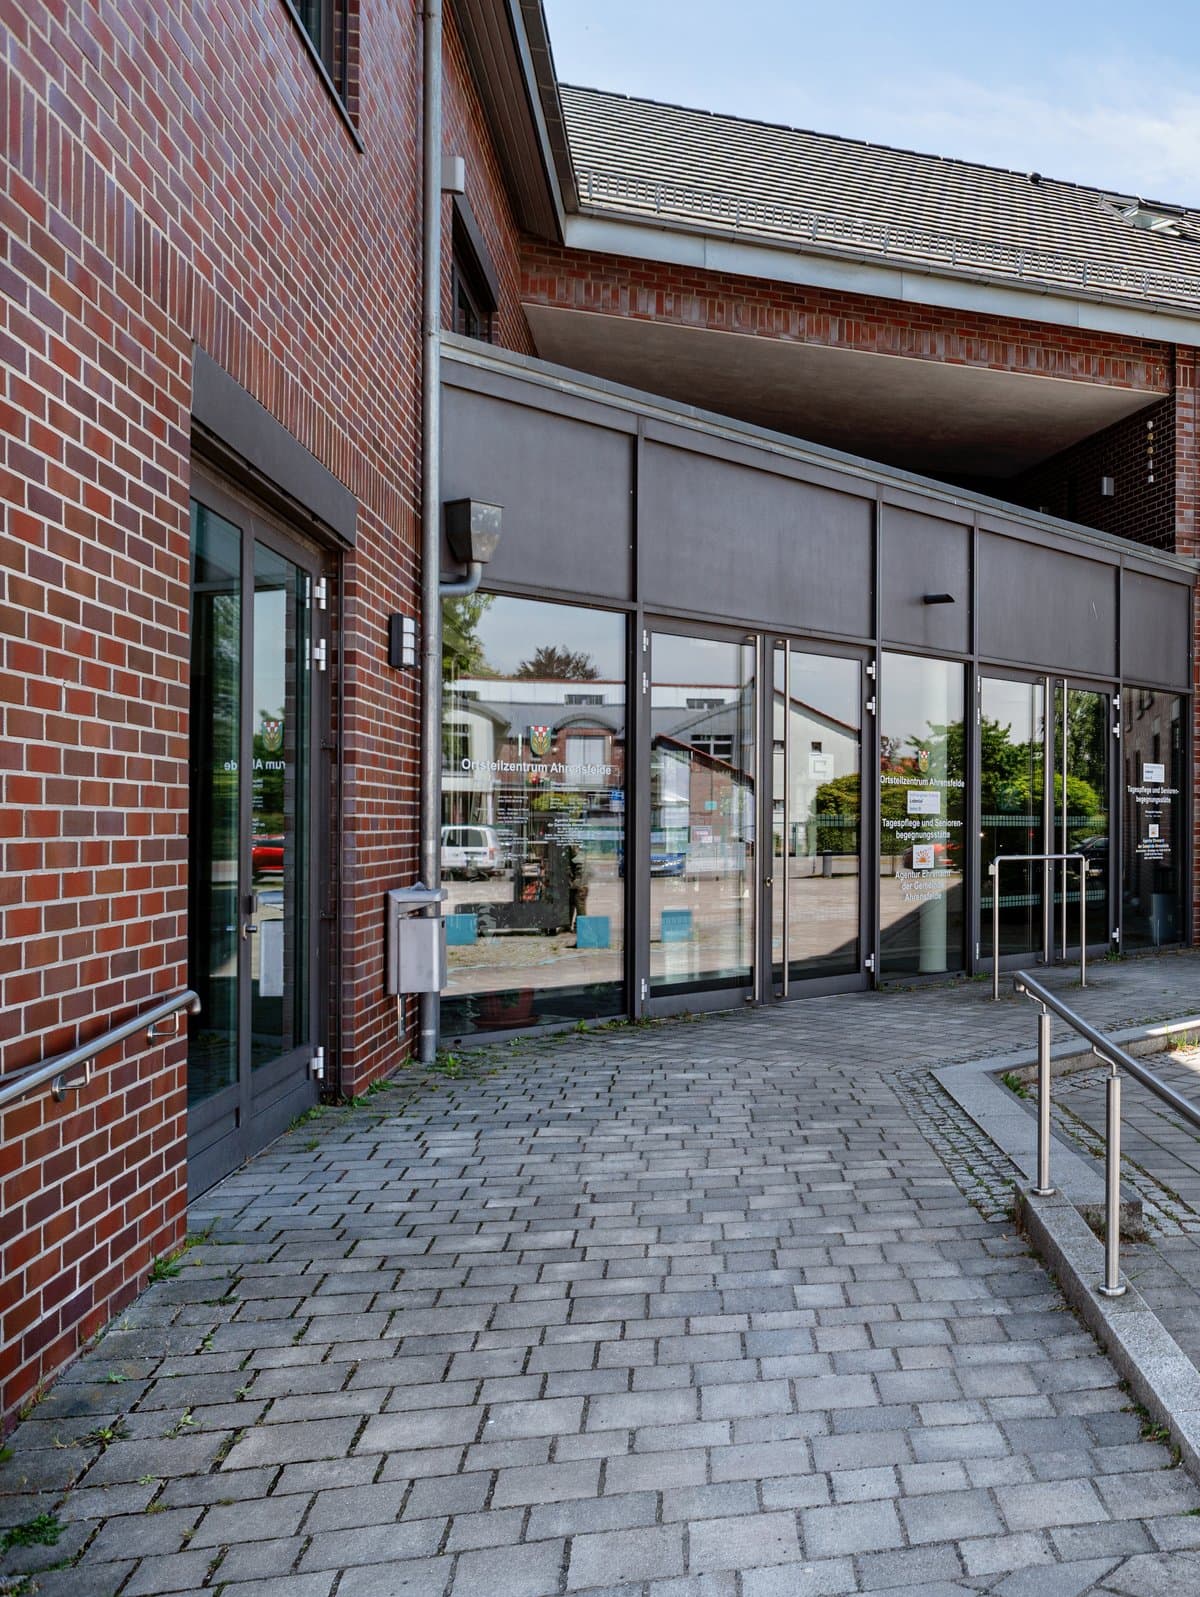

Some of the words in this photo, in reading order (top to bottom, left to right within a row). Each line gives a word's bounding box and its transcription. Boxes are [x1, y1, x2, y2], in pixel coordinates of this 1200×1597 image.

[461, 758, 548, 773] Ortsteilzentrum
[880, 775, 929, 786] Ortsteilzentrum
[882, 818, 920, 829] Tagespflege
[921, 819, 934, 828] und
[934, 819, 963, 828] Senioren-
